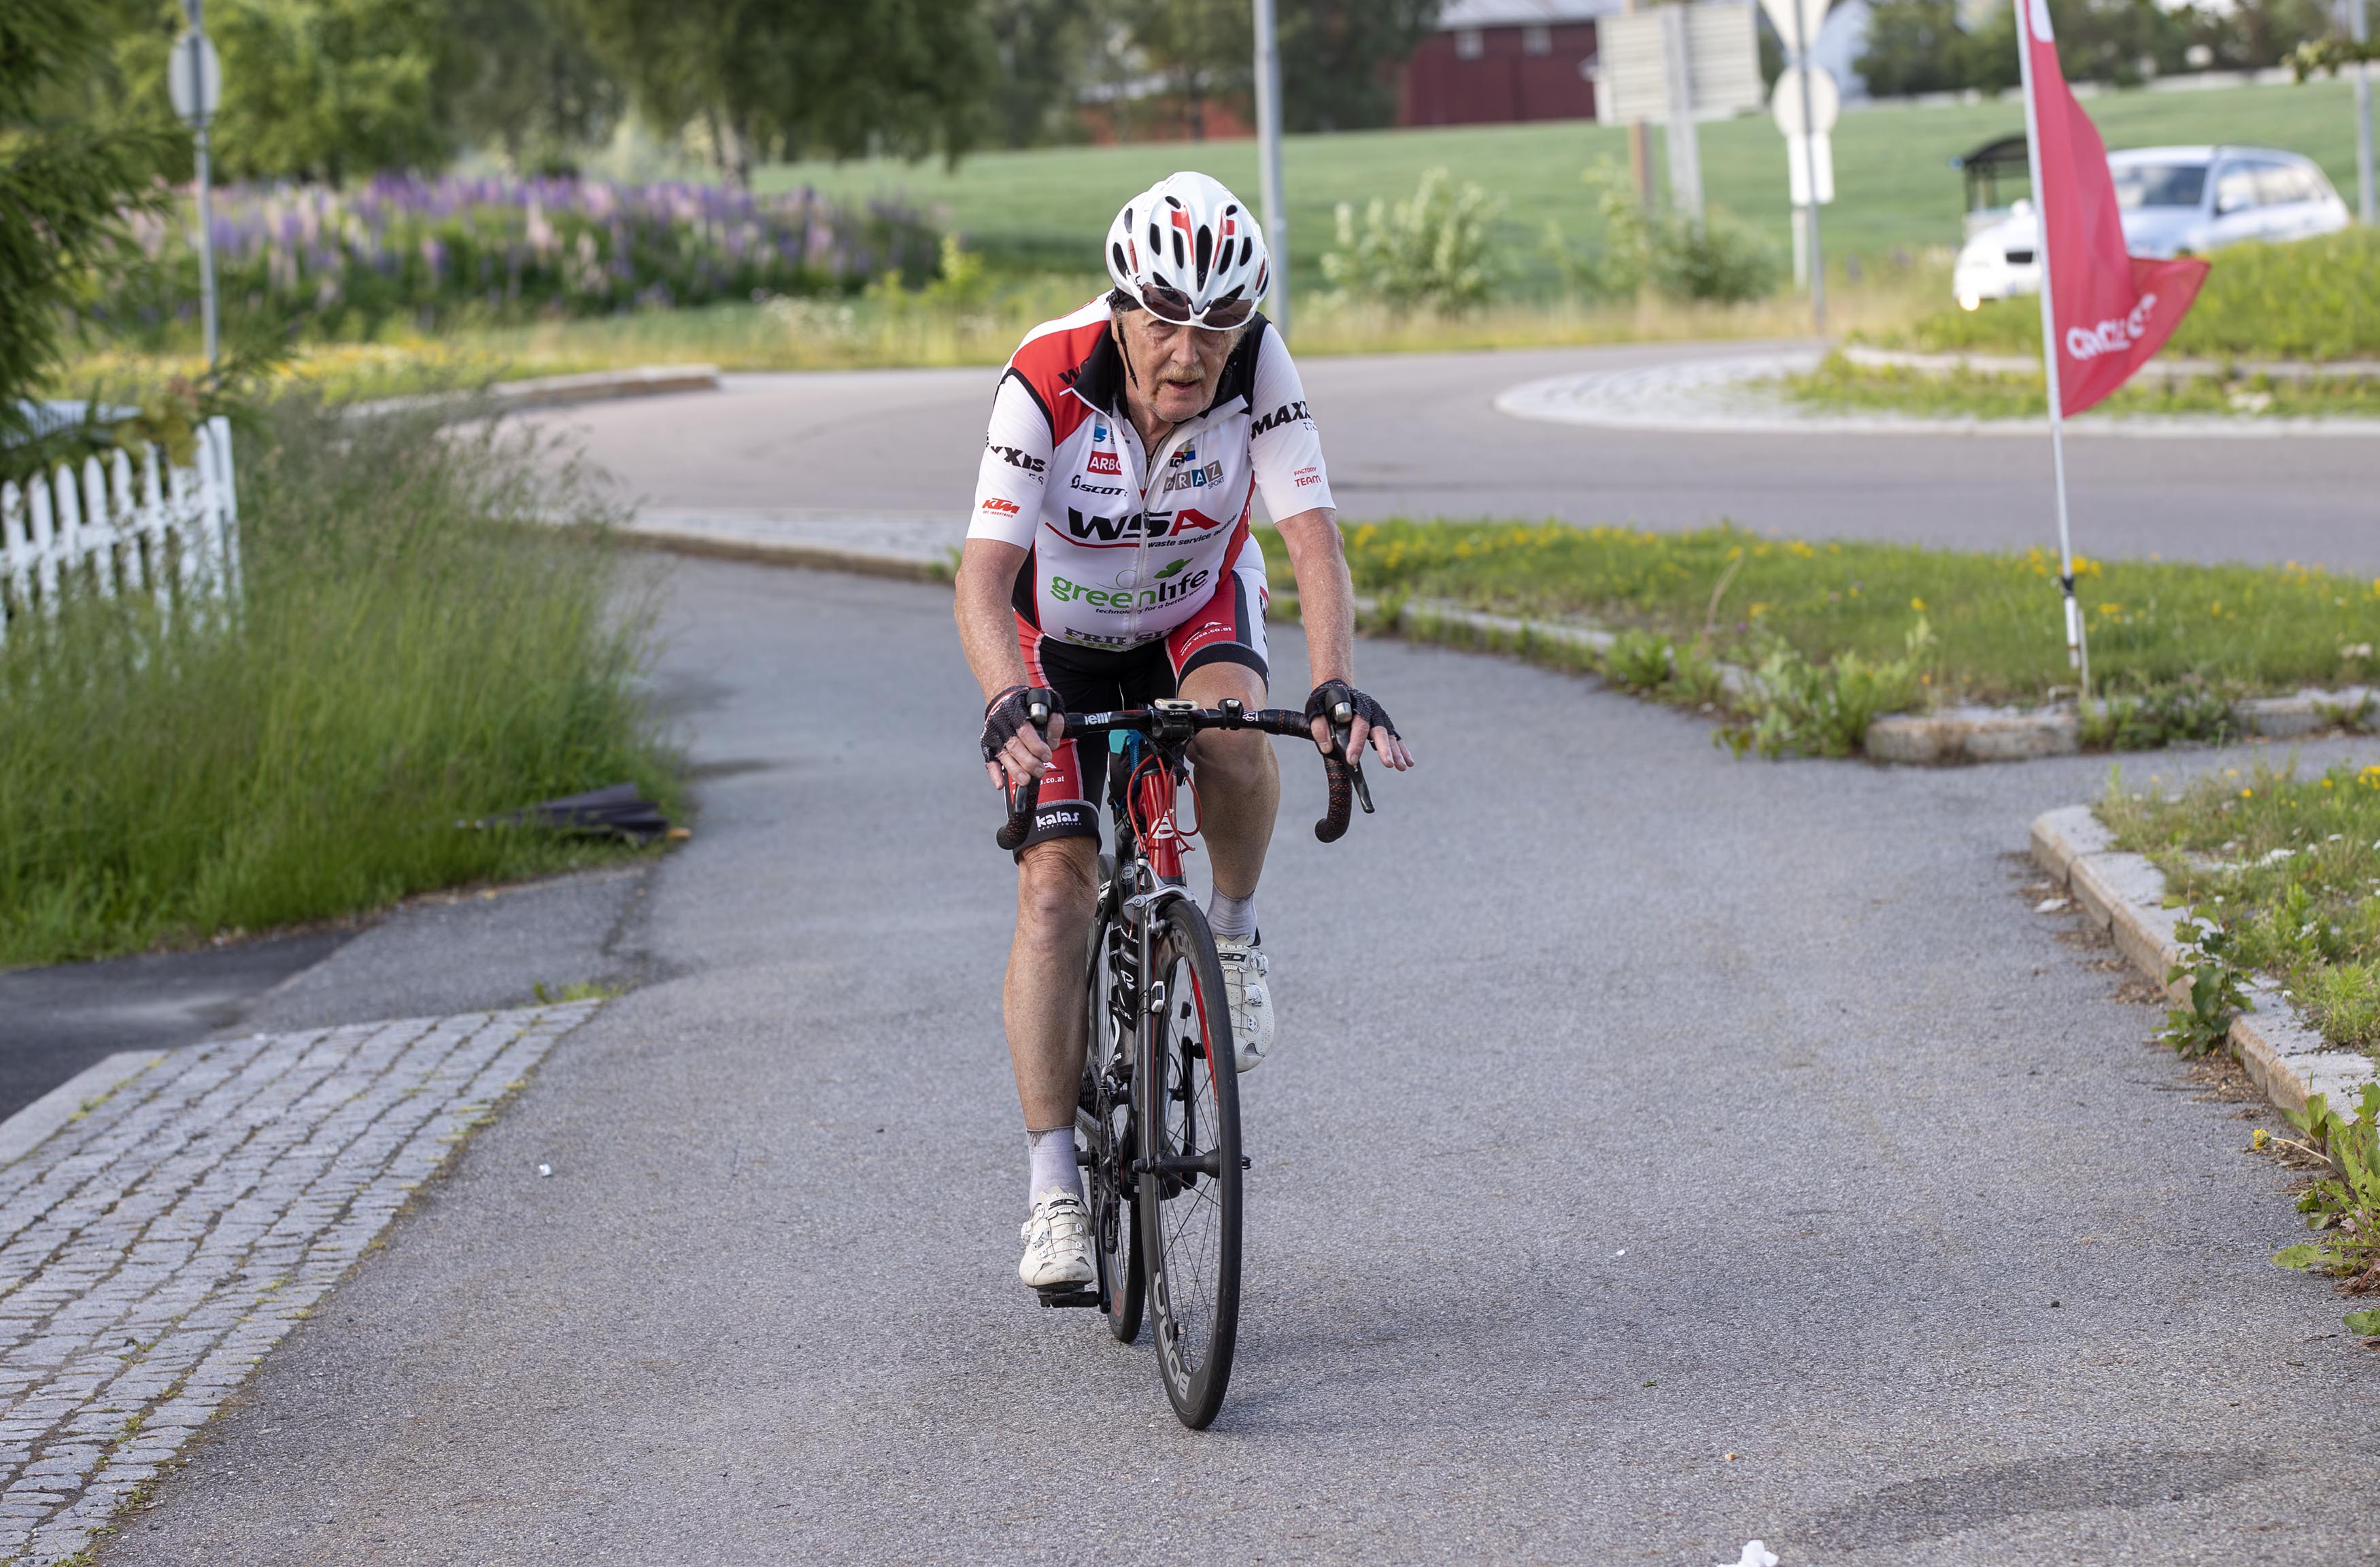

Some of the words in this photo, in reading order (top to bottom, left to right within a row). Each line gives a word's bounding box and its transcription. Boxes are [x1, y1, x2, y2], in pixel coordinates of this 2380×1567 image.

[1251, 400, 1312, 441] MAXX
[1293, 466, 1316, 477] FACTORY
[1208, 477, 1225, 489] SPORT
[1294, 475, 1322, 487] TEAM
[982, 498, 1021, 514] KTM
[1068, 506, 1221, 541] WSA
[1147, 539, 1176, 548] waste
[1178, 533, 1212, 545] service
[1165, 595, 1188, 607] better
[1036, 811, 1080, 828] kalas
